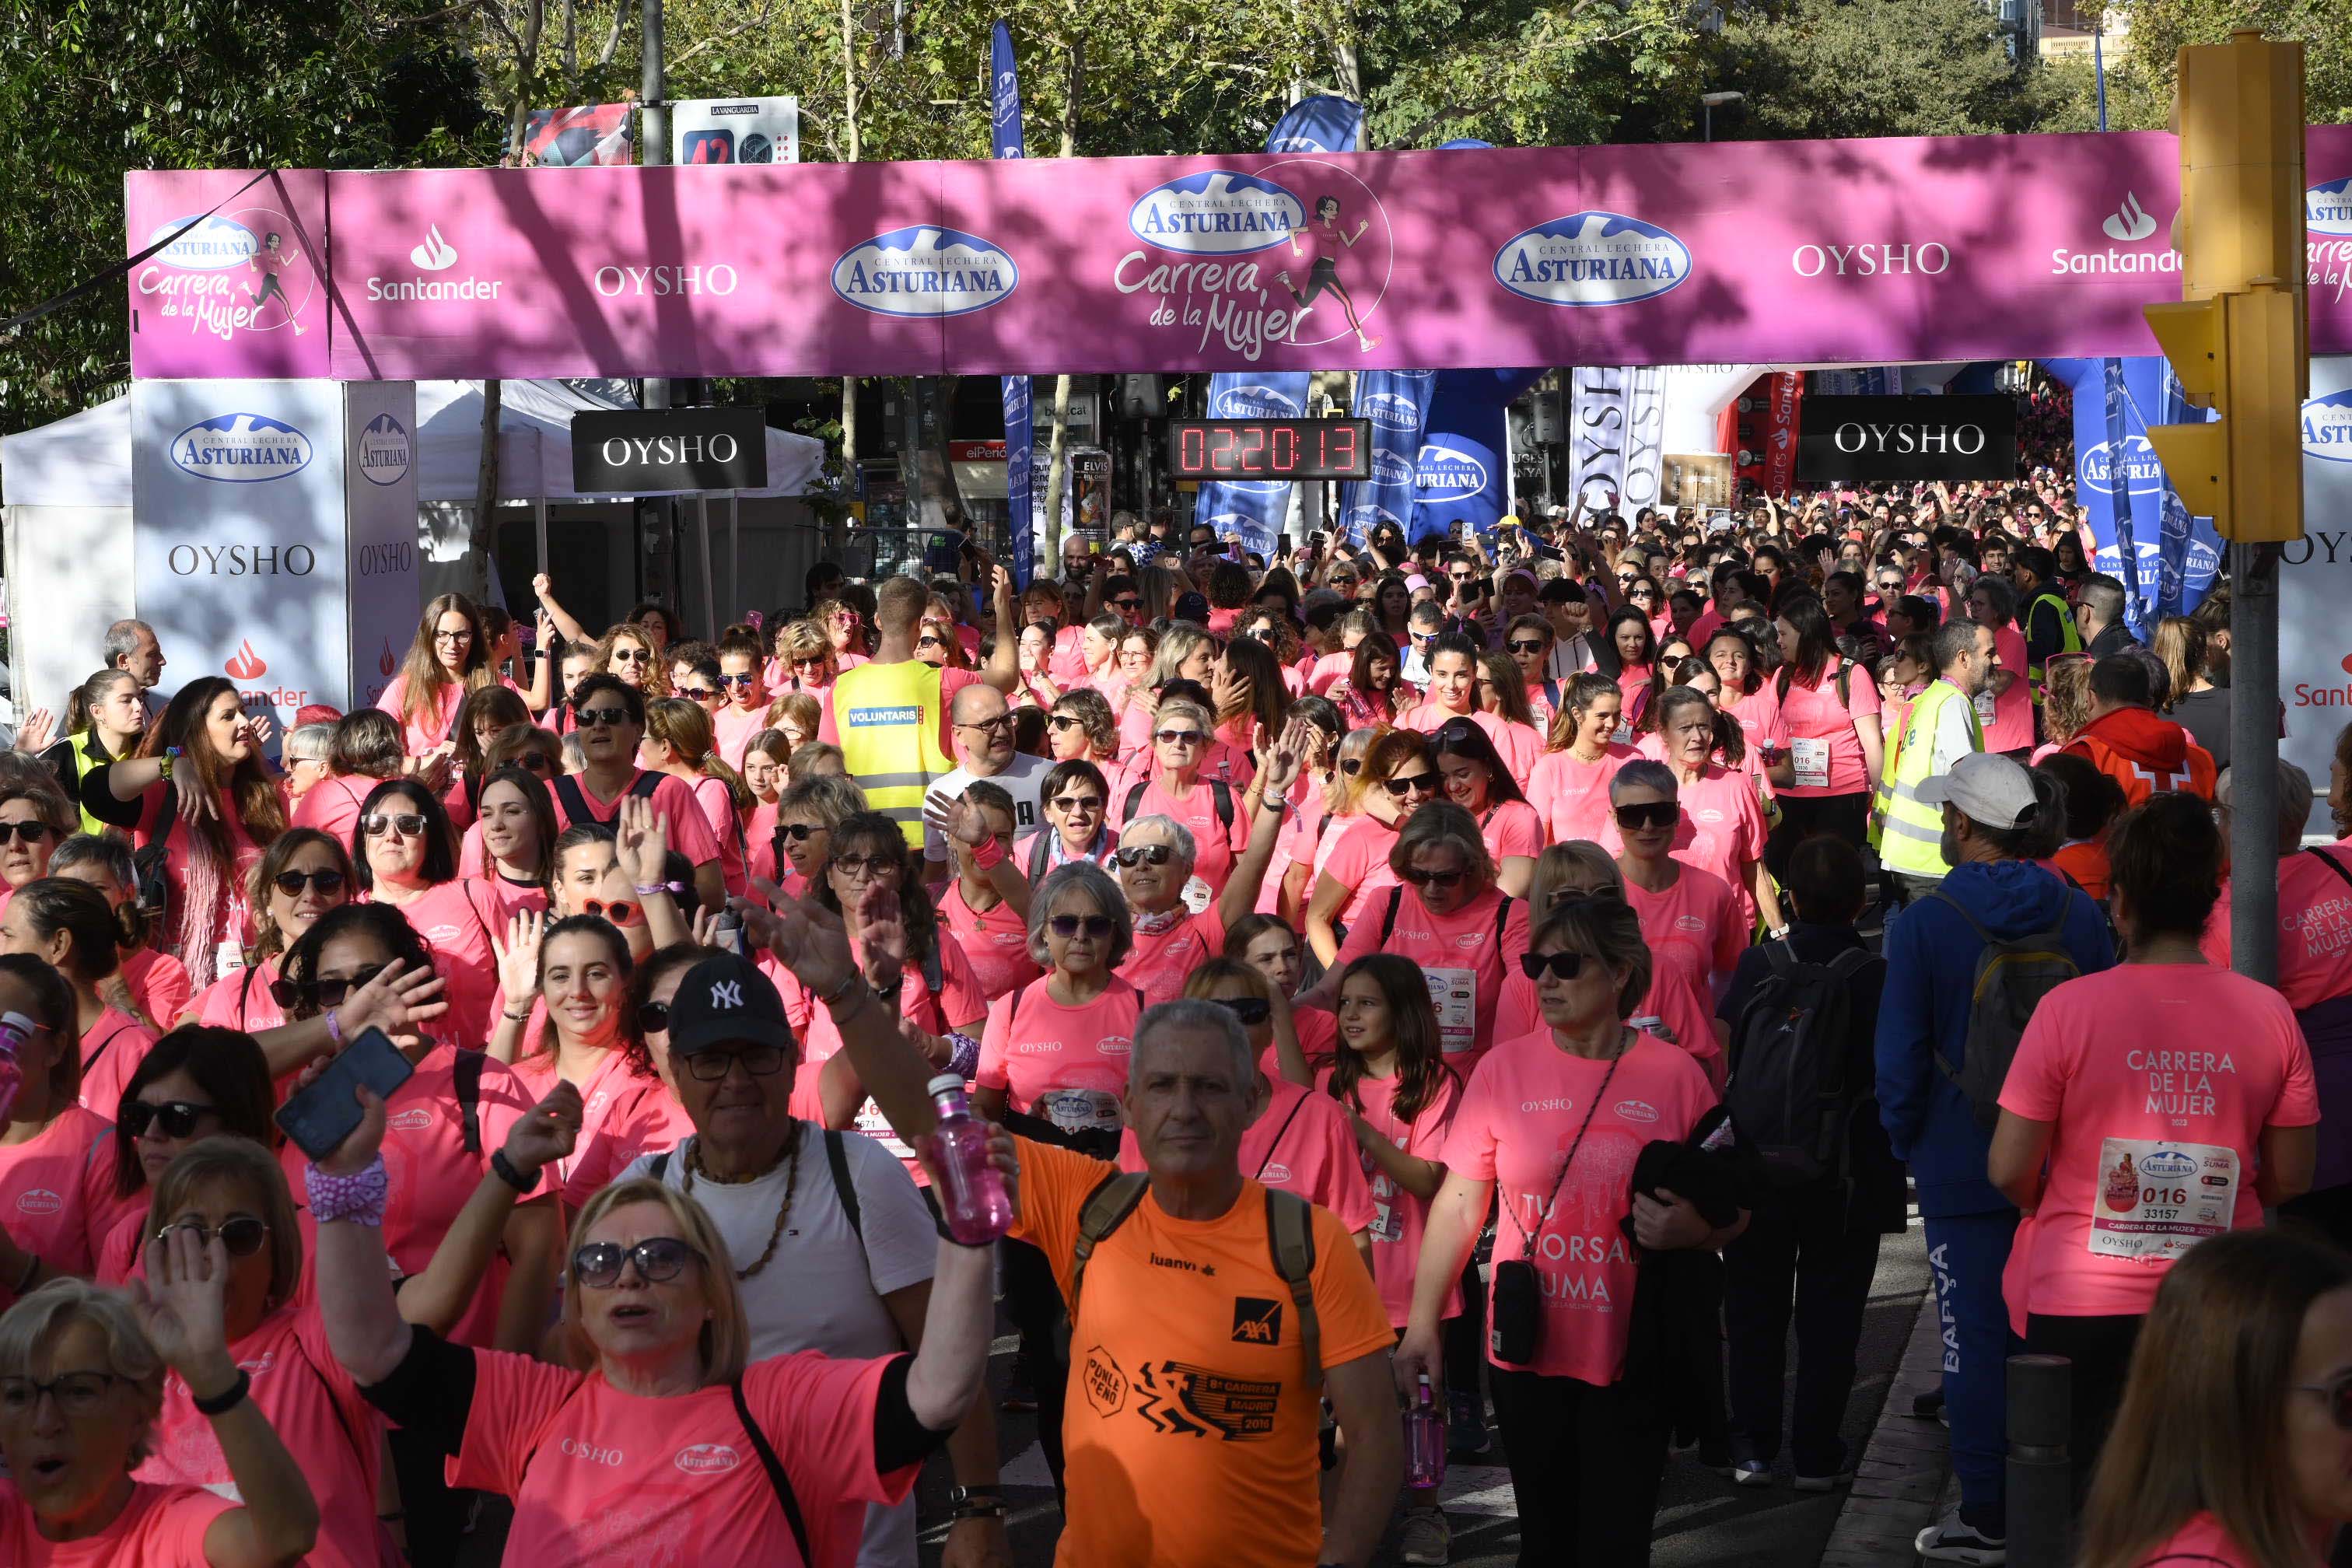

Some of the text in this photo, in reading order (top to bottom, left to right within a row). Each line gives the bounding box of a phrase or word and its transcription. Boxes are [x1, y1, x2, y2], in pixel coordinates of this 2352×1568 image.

[719, 105, 758, 114] VANGUARDIA
[1170, 198, 1286, 209] CENTRAL LECHERA
[1143, 203, 1292, 234] ASTURIANA
[1539, 243, 1671, 255] CENTRAL LECHERA
[1792, 242, 1951, 277] OYSHO
[874, 255, 998, 267] CENTRAL LECHERA
[1114, 250, 1259, 295] Carrera
[1508, 248, 1676, 282] ASTURIANA
[138, 266, 230, 296] Carrera
[366, 276, 502, 302] Santander
[593, 264, 738, 297] OYSHO
[846, 261, 1004, 294] ASTURIANA
[161, 296, 194, 317] de la
[192, 292, 266, 341] Mujer
[1150, 293, 1202, 327] de la
[1199, 289, 1314, 361] Mujer
[1363, 402, 1418, 426] ASTURIANA
[203, 436, 249, 445] CENTRAL
[602, 432, 738, 467] OYSHO
[1181, 428, 1355, 471] 02:20:13
[1834, 422, 1985, 454] OYSHO
[181, 439, 303, 465] ASTURIANA
[362, 440, 407, 468] ASTURIANA
[1083, 461, 1108, 471] ELVIS
[359, 541, 411, 576] OYSHO
[2278, 531, 2352, 565] OY
[168, 544, 315, 576] OYSHO
[850, 710, 916, 723] VOLUNTARIS
[1794, 756, 1810, 765] 016
[2302, 913, 2350, 941] DE LA
[1020, 1041, 1062, 1053] OYSHO
[2126, 1049, 2236, 1074] CARRERA
[2149, 1072, 2214, 1094] DE LA
[1521, 1098, 1573, 1113] OYSHO
[2145, 1094, 2216, 1116] MUJER
[2172, 1118, 2188, 1127] 2023
[2144, 1160, 2193, 1174] ASTURIANA
[2203, 1160, 2230, 1170] SUMA
[1521, 1194, 1555, 1220] TU
[2142, 1188, 2187, 1204] 016
[2144, 1209, 2179, 1220] 33157
[2108, 1222, 2144, 1231] CARRERA
[2102, 1236, 2143, 1248] OYSHO
[1237, 1320, 1272, 1341] AXA
[1224, 1382, 1276, 1395] CARRERA
[1244, 1417, 1271, 1430] 2016
